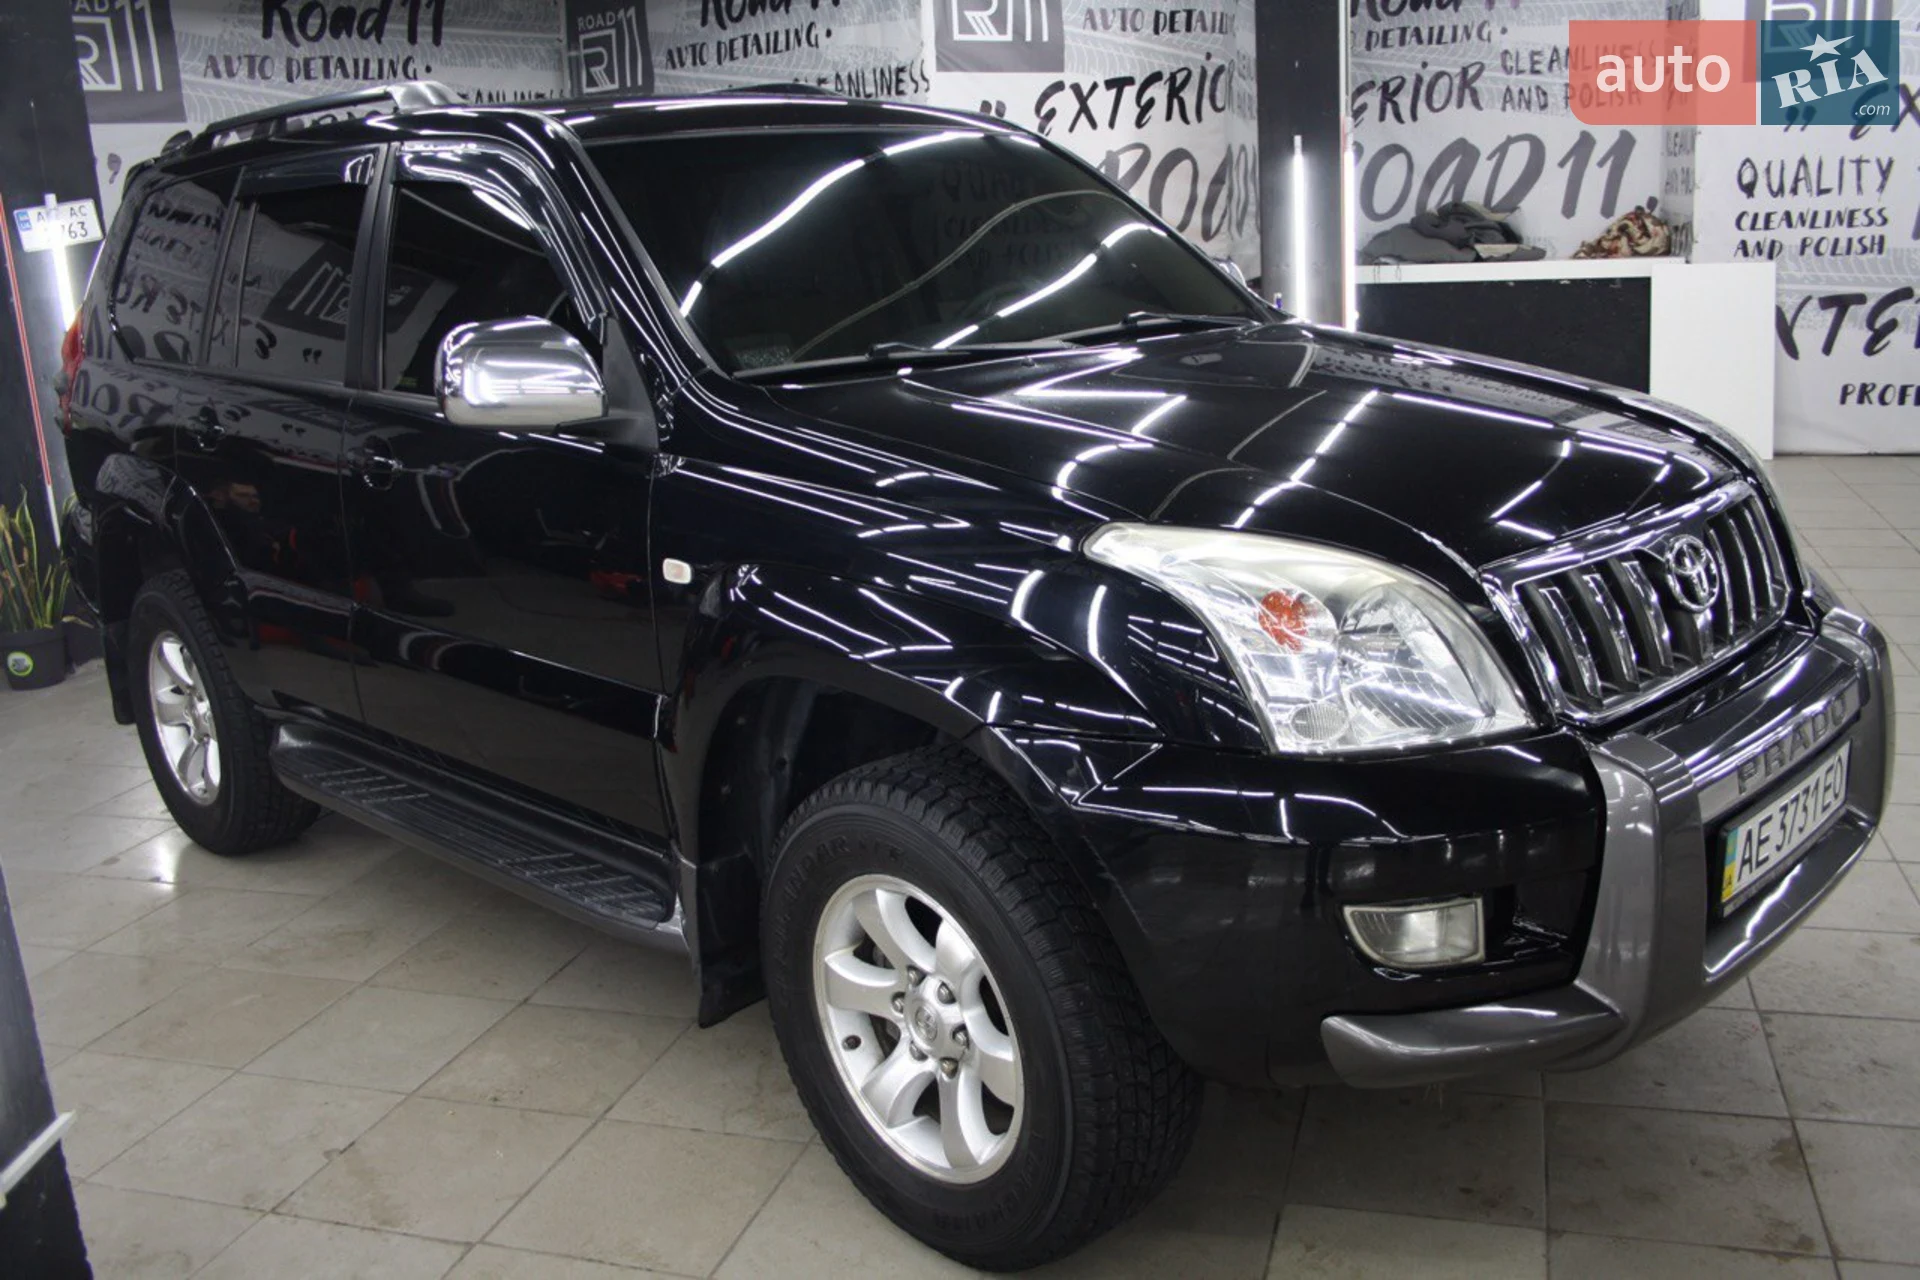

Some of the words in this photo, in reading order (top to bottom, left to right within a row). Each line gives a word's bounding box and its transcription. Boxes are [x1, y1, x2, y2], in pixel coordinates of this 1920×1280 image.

[577, 11, 616, 31] ROAD
[1082, 8, 1144, 34] AUTO
[665, 42, 707, 71] AUTO
[716, 21, 820, 67] DETAILING
[1365, 20, 1493, 51] DETAILING
[203, 54, 275, 80] AUTO
[286, 54, 418, 83] DETAILING
[1501, 84, 1549, 112] AND
[1737, 154, 1895, 201] QUALITY
[1735, 206, 1889, 232] CLEANLINESS
[1734, 237, 1784, 261] AND
[1799, 234, 1885, 257] POLISH
[1737, 695, 1847, 796] PRADO
